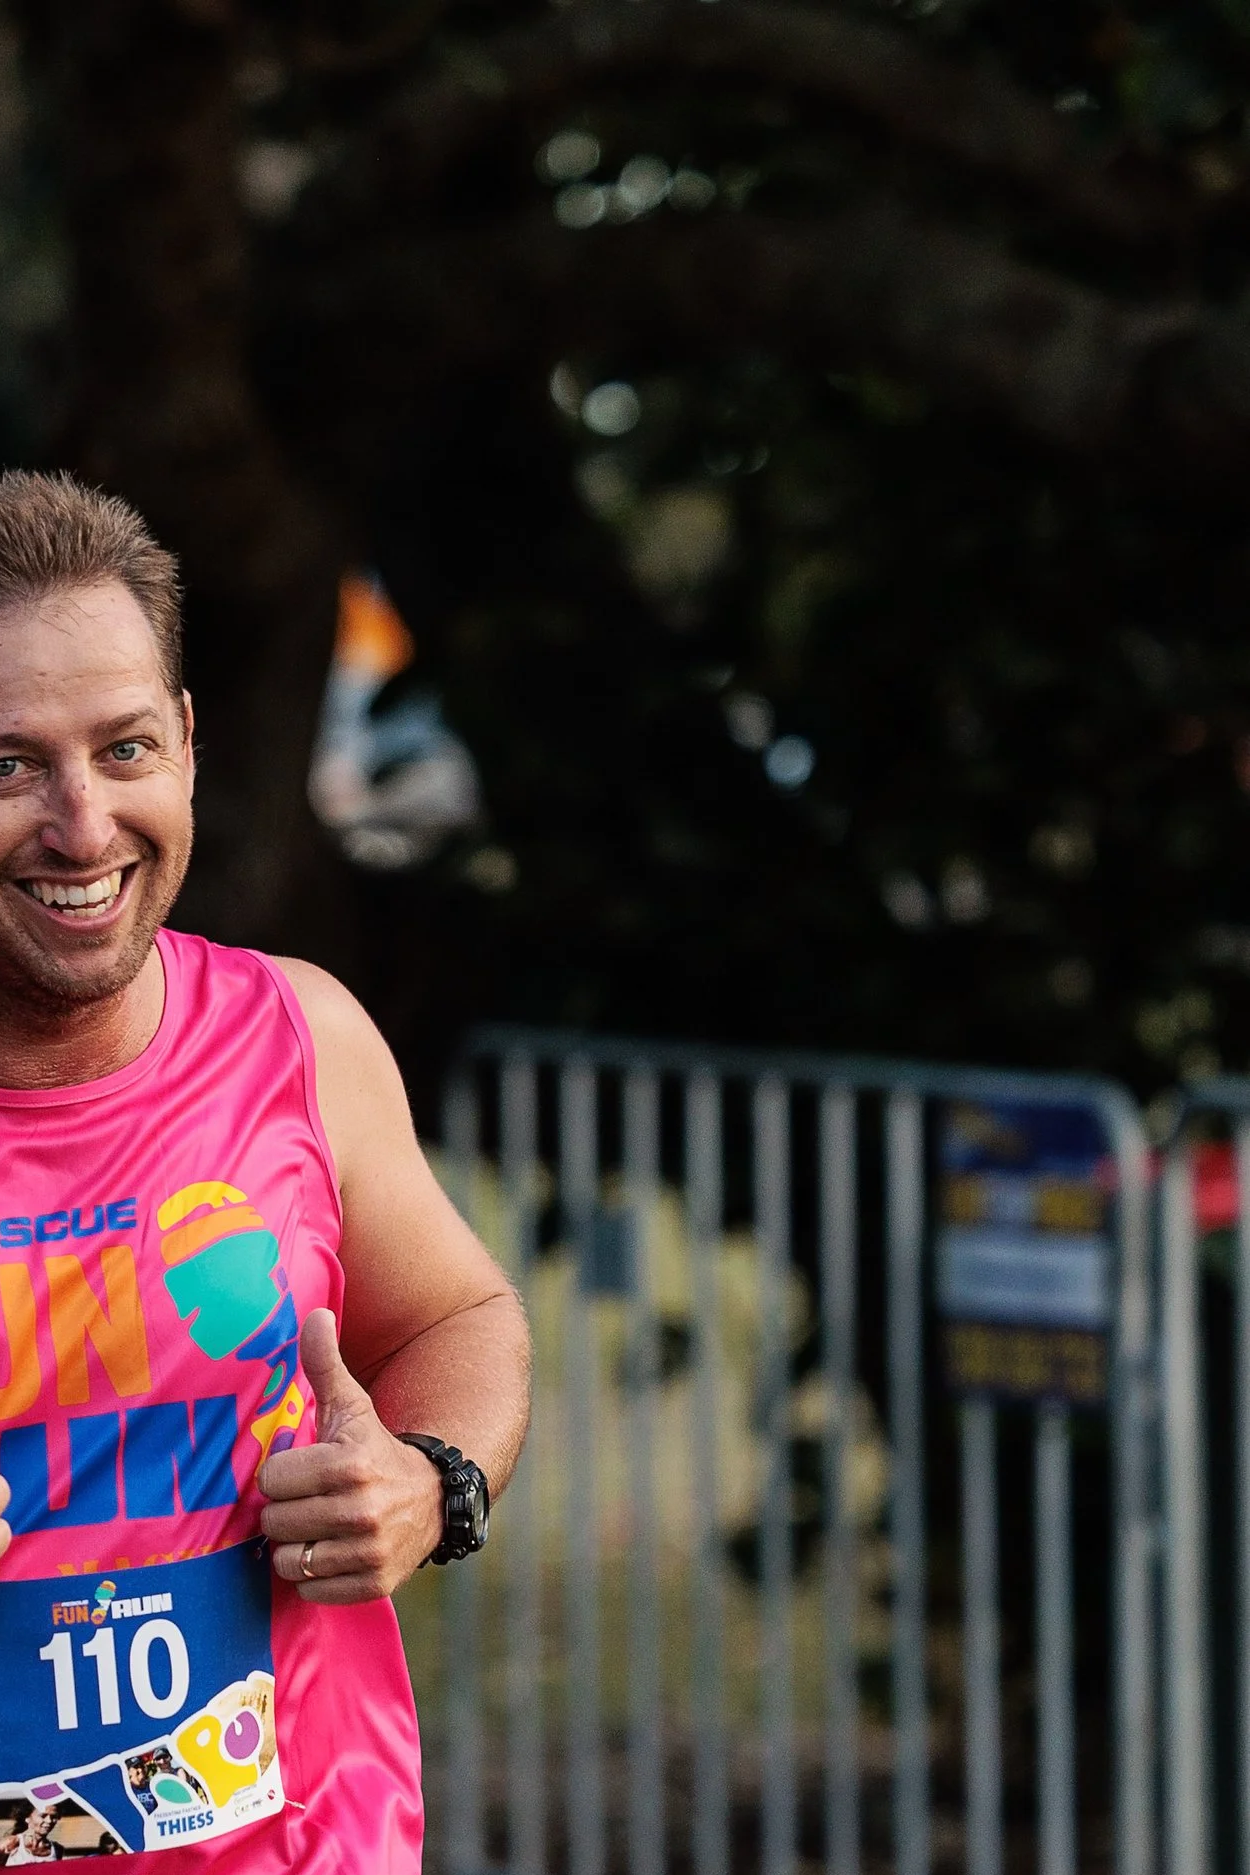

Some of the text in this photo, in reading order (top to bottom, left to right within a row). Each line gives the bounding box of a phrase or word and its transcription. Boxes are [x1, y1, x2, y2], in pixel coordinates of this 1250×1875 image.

[52, 1592, 173, 1627] FUN RUN
[39, 1618, 190, 1731] 110
[156, 1810, 215, 1837] THIESS
